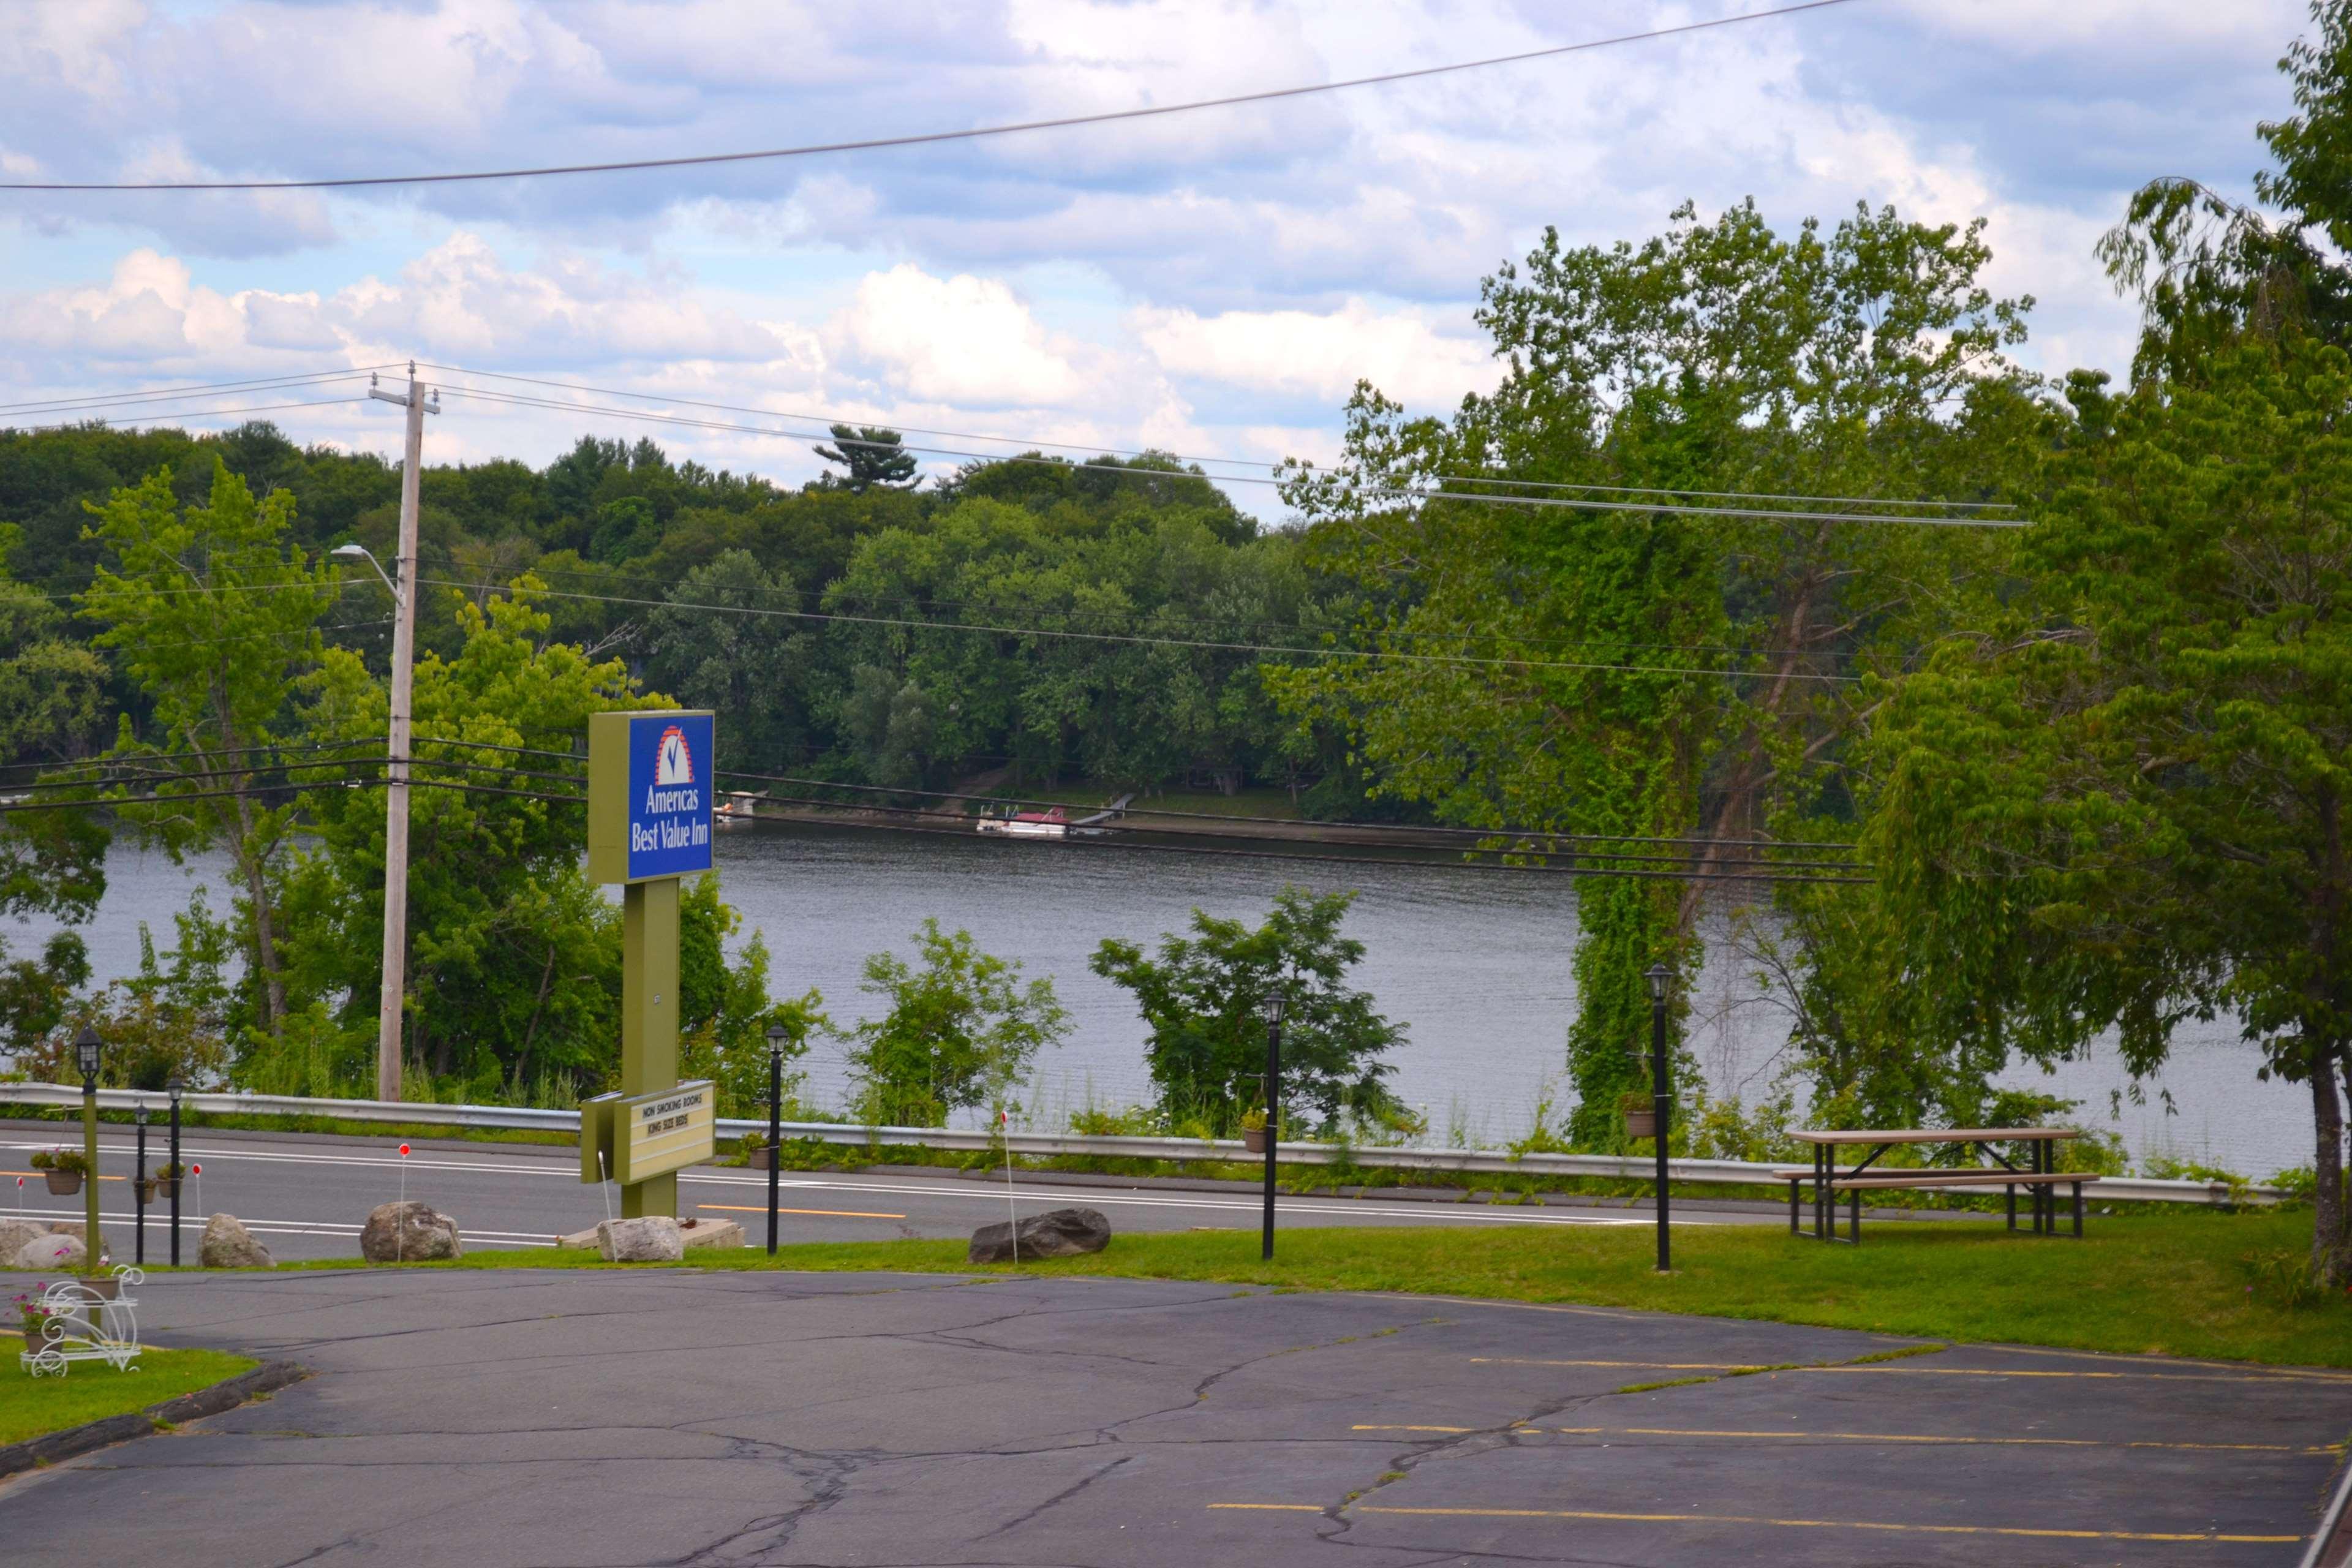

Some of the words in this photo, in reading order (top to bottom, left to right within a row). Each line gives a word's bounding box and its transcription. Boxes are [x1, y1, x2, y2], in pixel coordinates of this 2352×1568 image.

[646, 785, 698, 814] Americas
[632, 822, 658, 852] Best
[661, 816, 690, 849] Value
[692, 817, 708, 846] Inn
[643, 1106, 655, 1118] NON
[657, 1099, 681, 1114] SMOKING
[683, 1093, 702, 1107] ROOMS
[648, 1121, 662, 1134] KING
[663, 1118, 674, 1129] SIZE
[676, 1114, 688, 1126] BEDS
